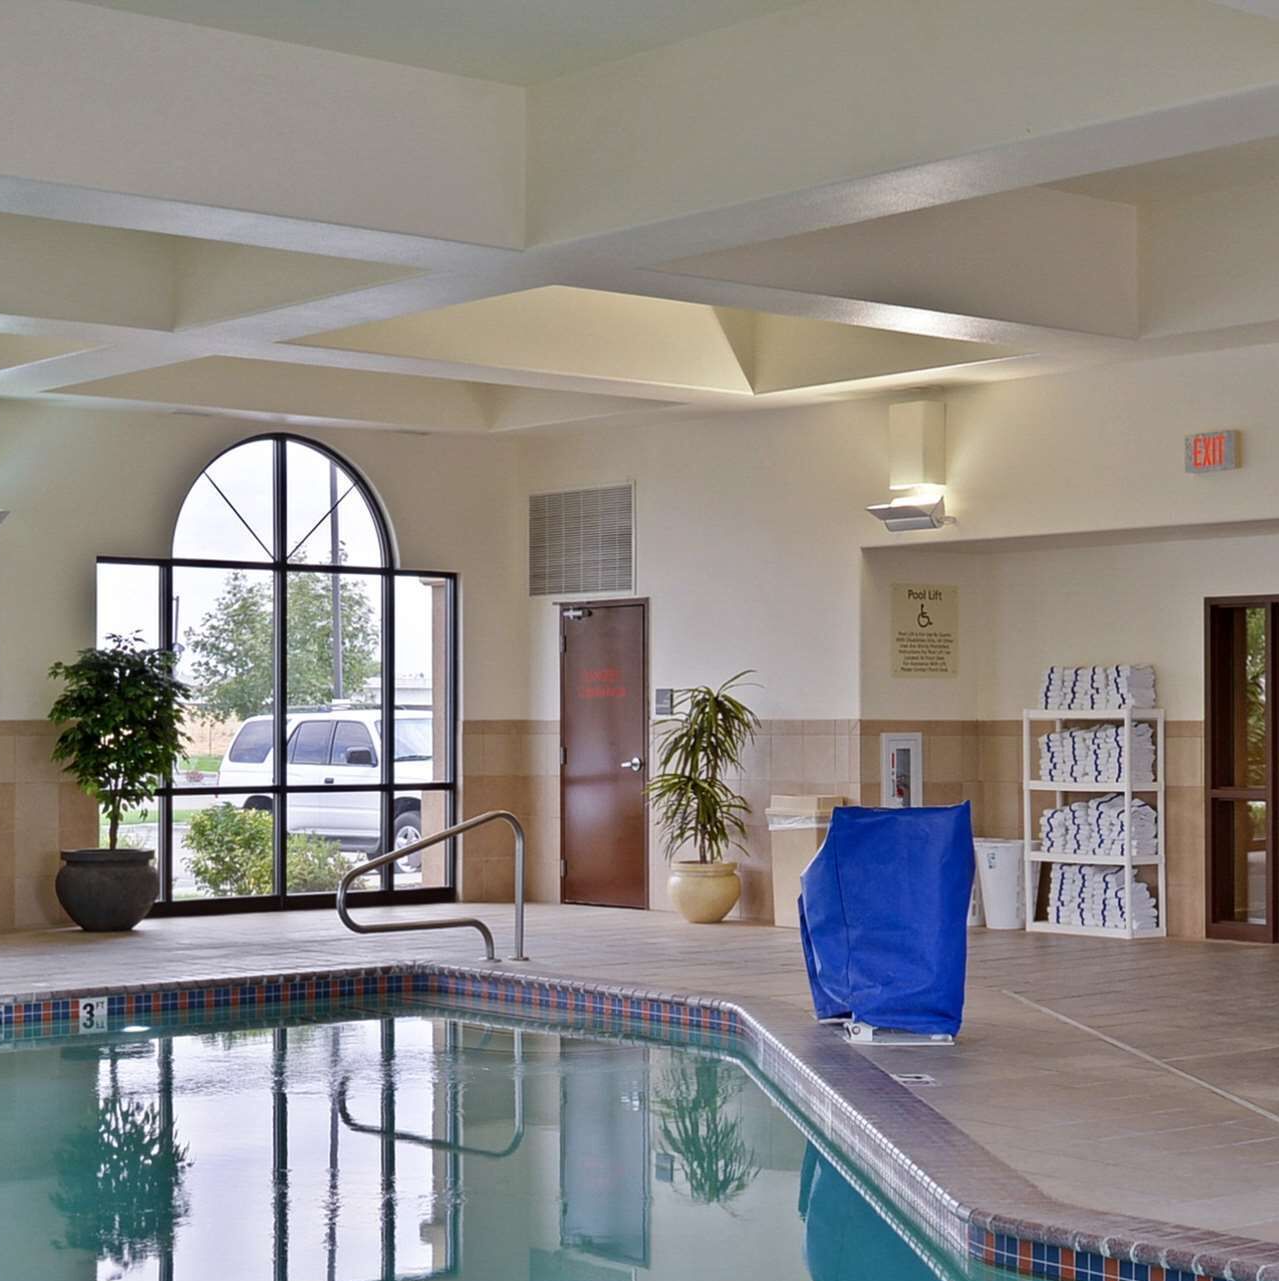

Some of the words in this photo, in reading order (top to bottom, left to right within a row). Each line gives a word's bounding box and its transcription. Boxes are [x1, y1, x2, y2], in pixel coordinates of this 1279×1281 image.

[1192, 434, 1225, 467] EXIT
[908, 589, 926, 600] Pool
[928, 589, 942, 600] Lift
[83, 1003, 95, 1018] 3
